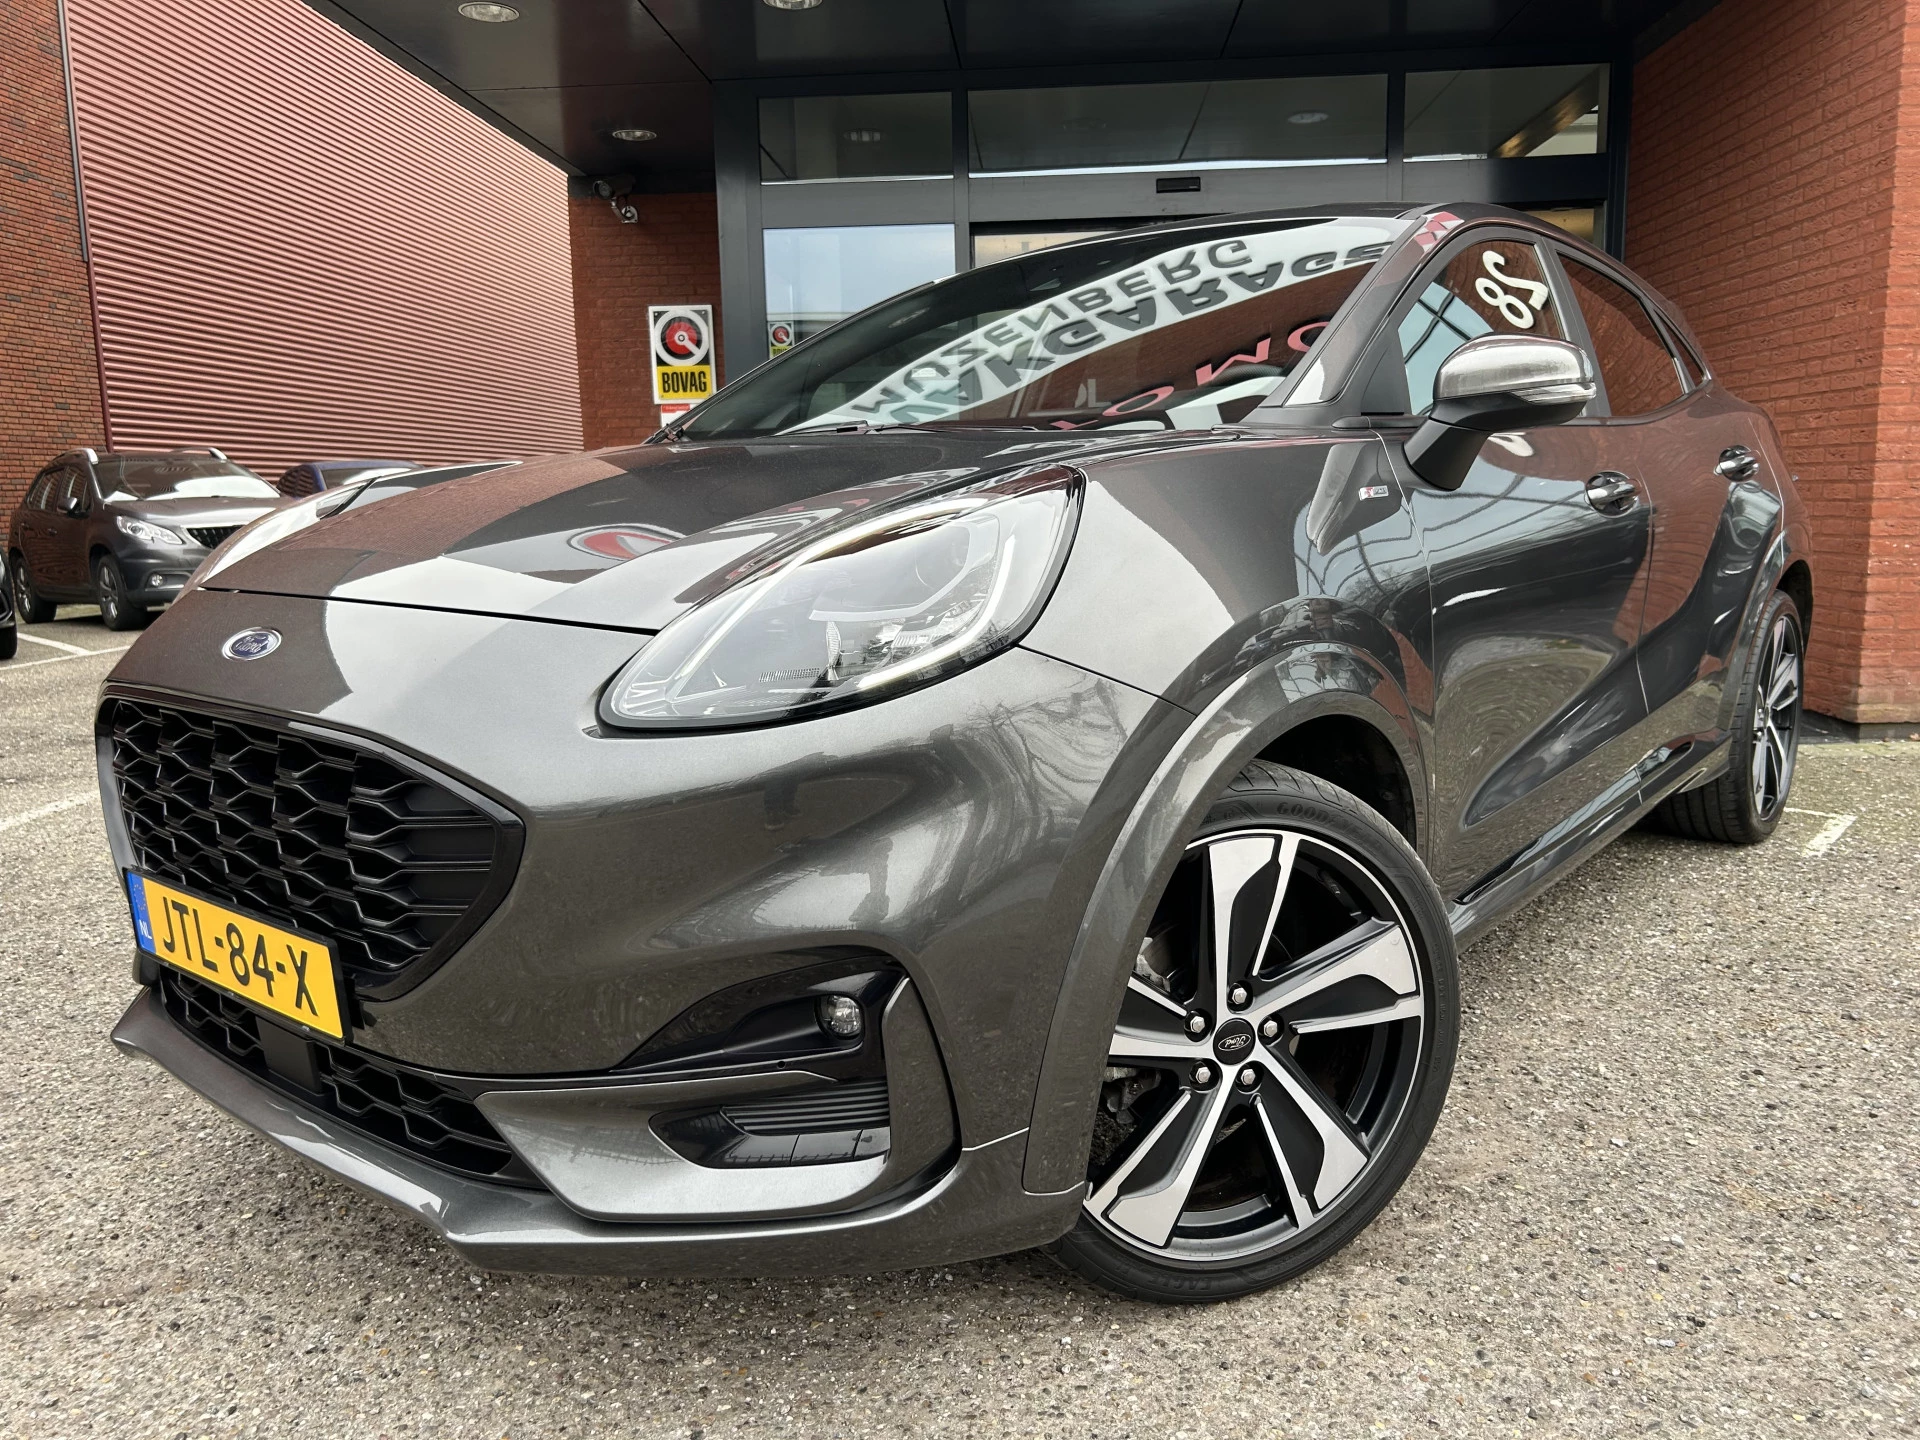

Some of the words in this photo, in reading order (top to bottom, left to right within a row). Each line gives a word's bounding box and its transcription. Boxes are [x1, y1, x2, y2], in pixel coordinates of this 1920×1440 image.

[662, 371, 707, 393] BOVAG
[235, 635, 270, 654] Ford
[139, 919, 152, 940] NL
[162, 896, 319, 1017] JTL-84-X
[1224, 1036, 1247, 1049] Ford
